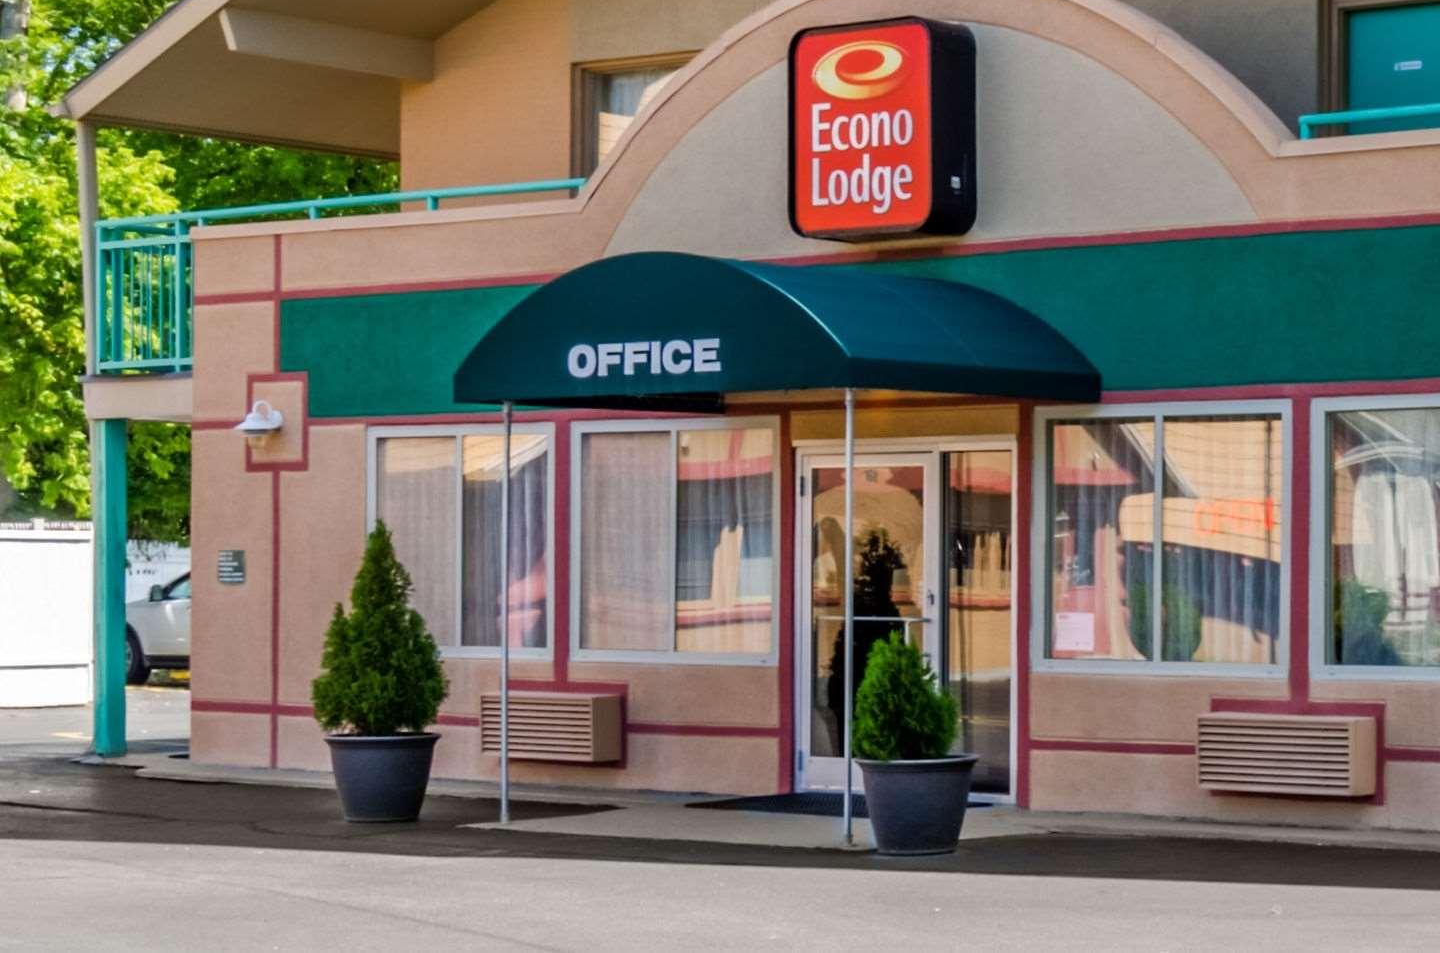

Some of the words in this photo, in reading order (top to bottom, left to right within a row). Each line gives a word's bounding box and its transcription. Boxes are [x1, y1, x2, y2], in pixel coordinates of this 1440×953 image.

[811, 102, 913, 153] Econo
[811, 153, 913, 214] Lodge
[567, 338, 722, 378] OFFICE
